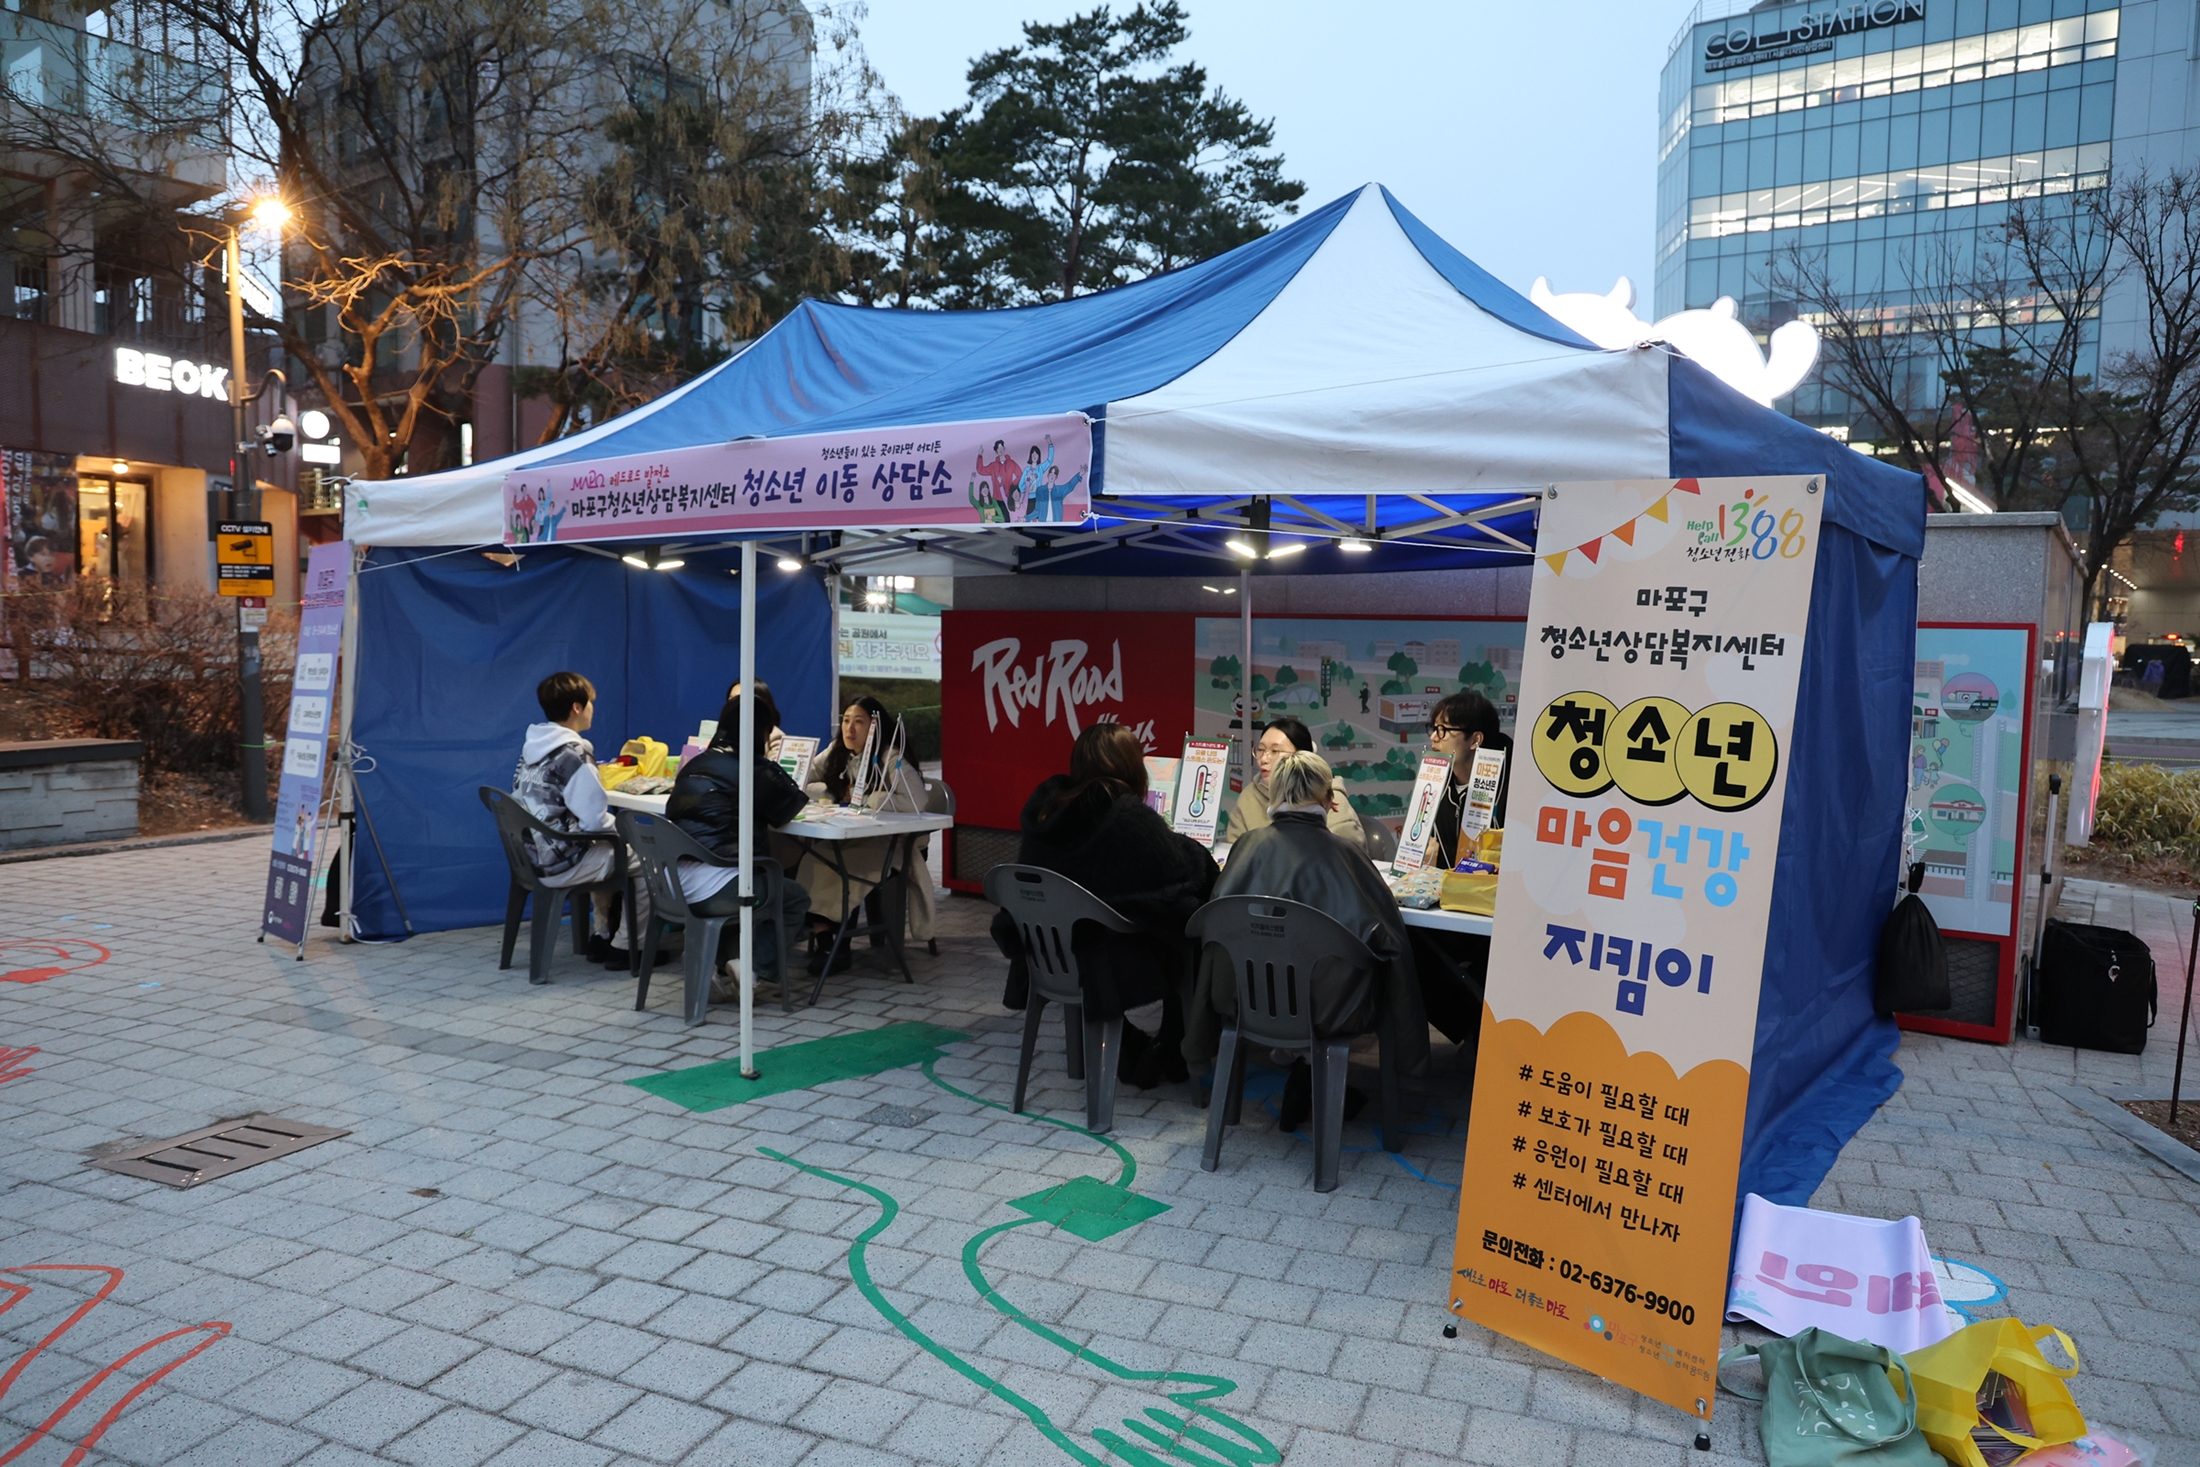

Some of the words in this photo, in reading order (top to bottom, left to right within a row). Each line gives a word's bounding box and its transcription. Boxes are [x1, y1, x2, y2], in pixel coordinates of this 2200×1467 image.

[1797, 0, 1924, 40] STATION
[116, 347, 229, 401] BEOK
[609, 469, 641, 486] 레드로드
[644, 464, 670, 489] 발전소
[821, 446, 858, 461] 청소년들이
[861, 445, 876, 458] 있는
[880, 443, 914, 456] 곳이라면
[916, 440, 942, 454] 어디든
[571, 482, 736, 518] 마포구청소년상담복지센터
[742, 466, 806, 507] 청소년
[816, 463, 859, 503] 이동
[872, 459, 952, 502] 상담소
[221, 525, 241, 533] CCTV
[1687, 520, 1714, 532] Help
[1718, 502, 1806, 560] 1388
[1636, 586, 1708, 617] 마포구
[856, 641, 930, 661] 지켜주세요
[1540, 625, 1785, 671] 청소년상담복지센터
[1476, 762, 1499, 778] 마포구
[1546, 700, 1755, 798] 청소년
[1543, 923, 1714, 1016] 지킴이
[1518, 1064, 1533, 1081] #
[1540, 1069, 1592, 1099] 도움이
[1600, 1083, 1658, 1121] 필요할
[1664, 1104, 1690, 1127] 때
[1517, 1100, 1532, 1117] #
[1538, 1107, 1591, 1136] 보호가
[1599, 1121, 1656, 1159] 필요할
[1662, 1143, 1689, 1166] 때
[1512, 1135, 1527, 1153] #
[1533, 1138, 1587, 1173] 응원이
[1595, 1157, 1652, 1197] 필요할
[1658, 1181, 1684, 1204] 때
[1512, 1172, 1527, 1189] #
[1533, 1177, 1612, 1220] 센터에서
[1620, 1205, 1681, 1243] 만나자
[1457, 1268, 1487, 1288] 새로운
[1488, 1278, 1512, 1297] 마포
[1515, 1288, 1529, 1305] 더
[1528, 1293, 1545, 1311] 좋은
[1546, 1300, 1570, 1321] 마포
[1482, 1229, 1544, 1269] 문의전화
[1560, 1259, 1695, 1326] 02-6376-9900
[1608, 1320, 1639, 1348] 마포구
